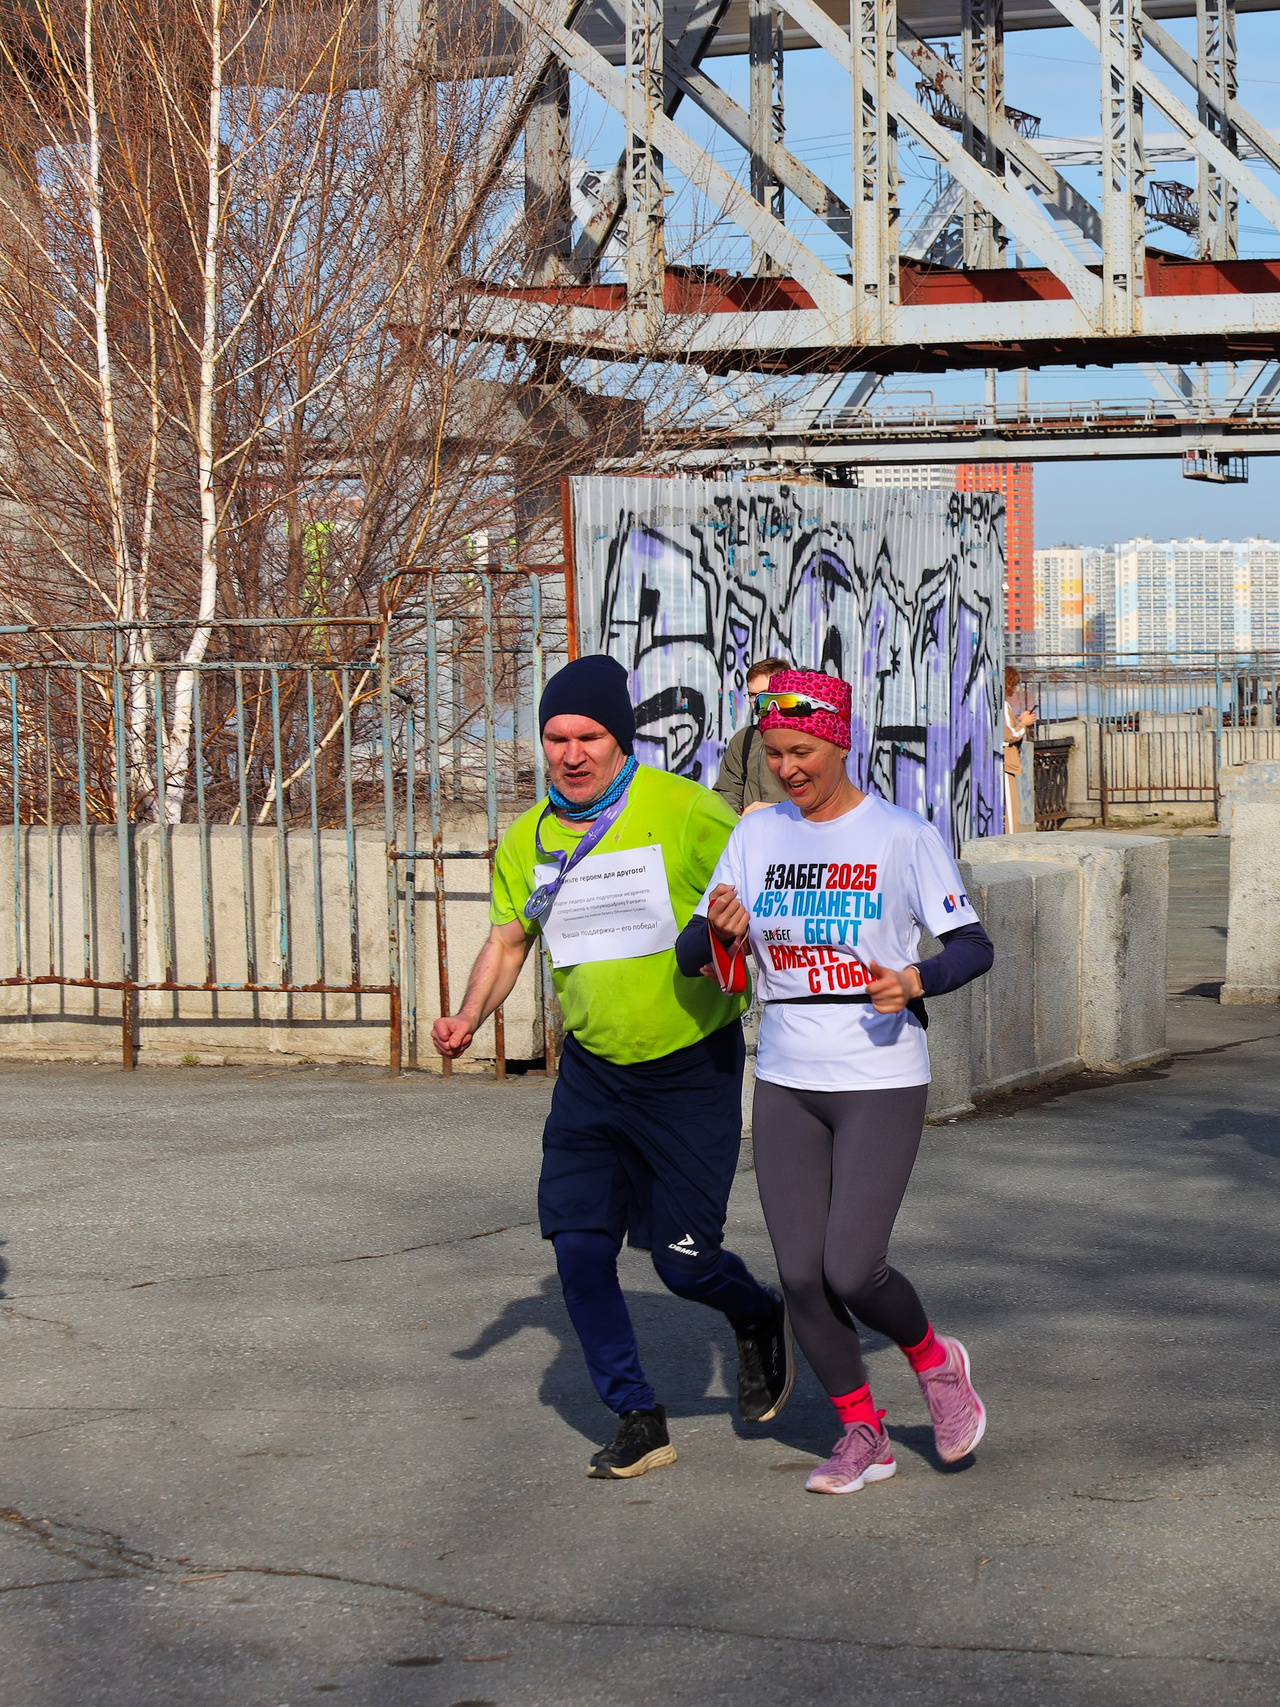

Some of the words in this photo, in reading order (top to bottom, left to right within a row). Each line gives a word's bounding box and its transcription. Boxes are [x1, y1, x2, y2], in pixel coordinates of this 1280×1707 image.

[579, 873, 603, 883] героем
[603, 871, 616, 880] для
[616, 865, 646, 877] другого!
[764, 863, 877, 891] #ЗАБЕГ2025
[753, 891, 788, 918] 45%
[791, 891, 883, 920] ПЛАНЕТЫ
[561, 930, 580, 939] Ваша
[580, 926, 616, 937] поддержка
[621, 924, 633, 932] его
[632, 921, 658, 931] победа!
[804, 918, 862, 947] БЕГУТ
[767, 945, 840, 972] ВМЕСТЕ
[808, 967, 821, 993] С
[823, 960, 877, 991] ТОБО
